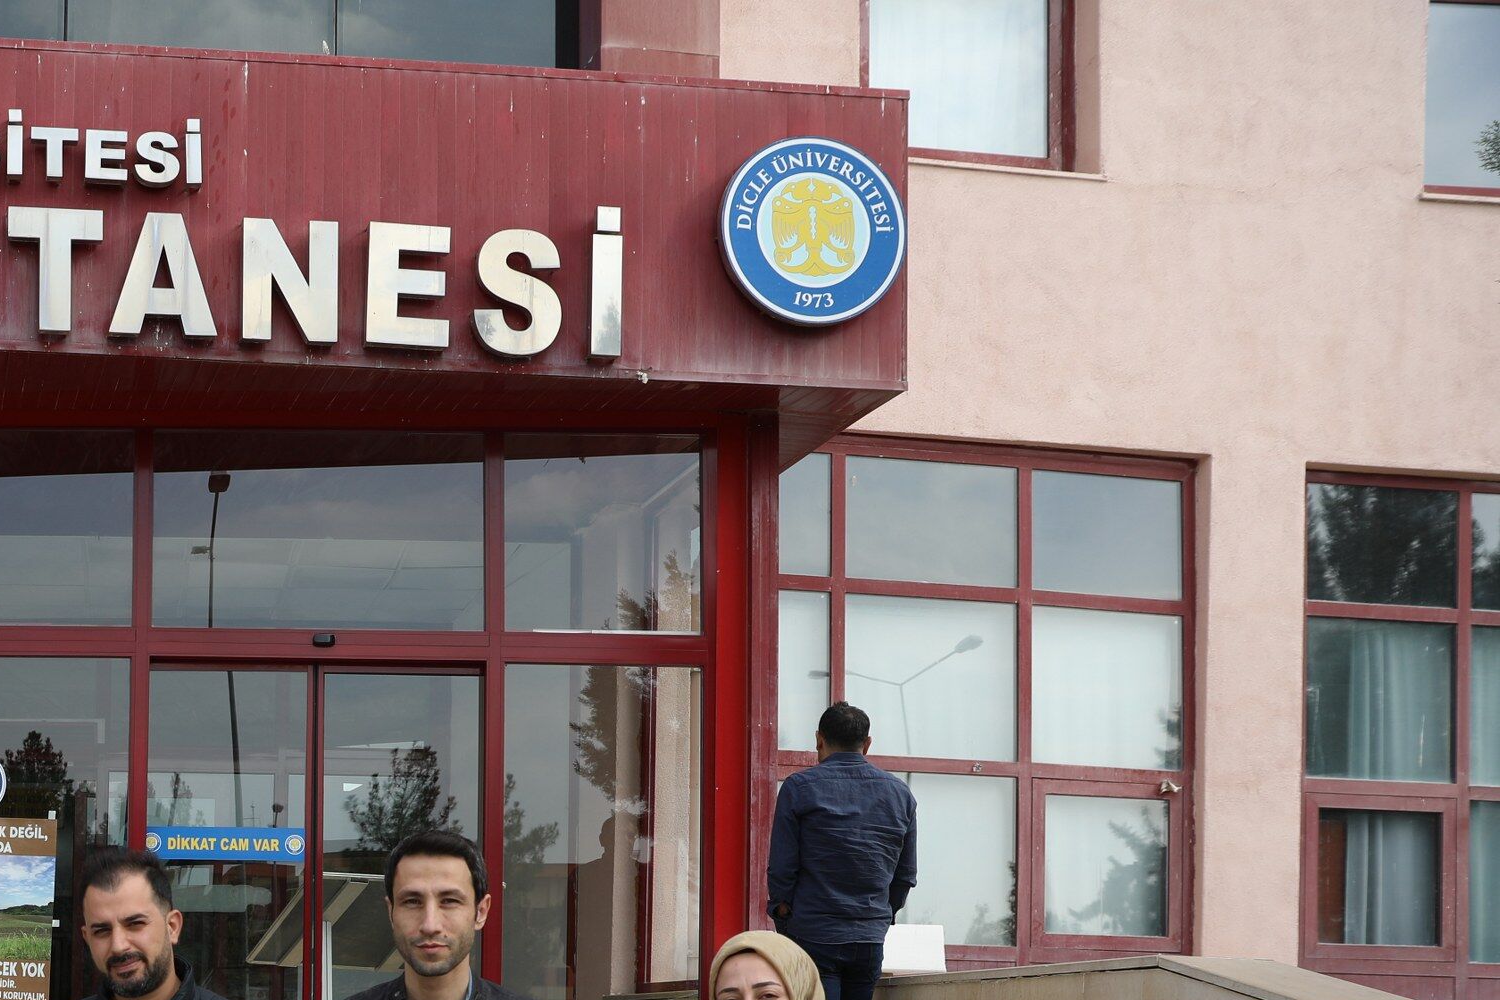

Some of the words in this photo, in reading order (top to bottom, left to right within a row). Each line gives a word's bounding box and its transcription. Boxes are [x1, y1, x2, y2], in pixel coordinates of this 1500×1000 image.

[736, 169, 773, 231] DİCLE
[771, 149, 894, 233] ÜNİVERSİTESİ
[793, 291, 835, 309] 1973
[9, 823, 49, 842] DEĞİL,
[167, 835, 216, 850] DİKKAT
[220, 838, 249, 851] CAM
[253, 839, 280, 852] VAR
[21, 962, 46, 978] YOK
